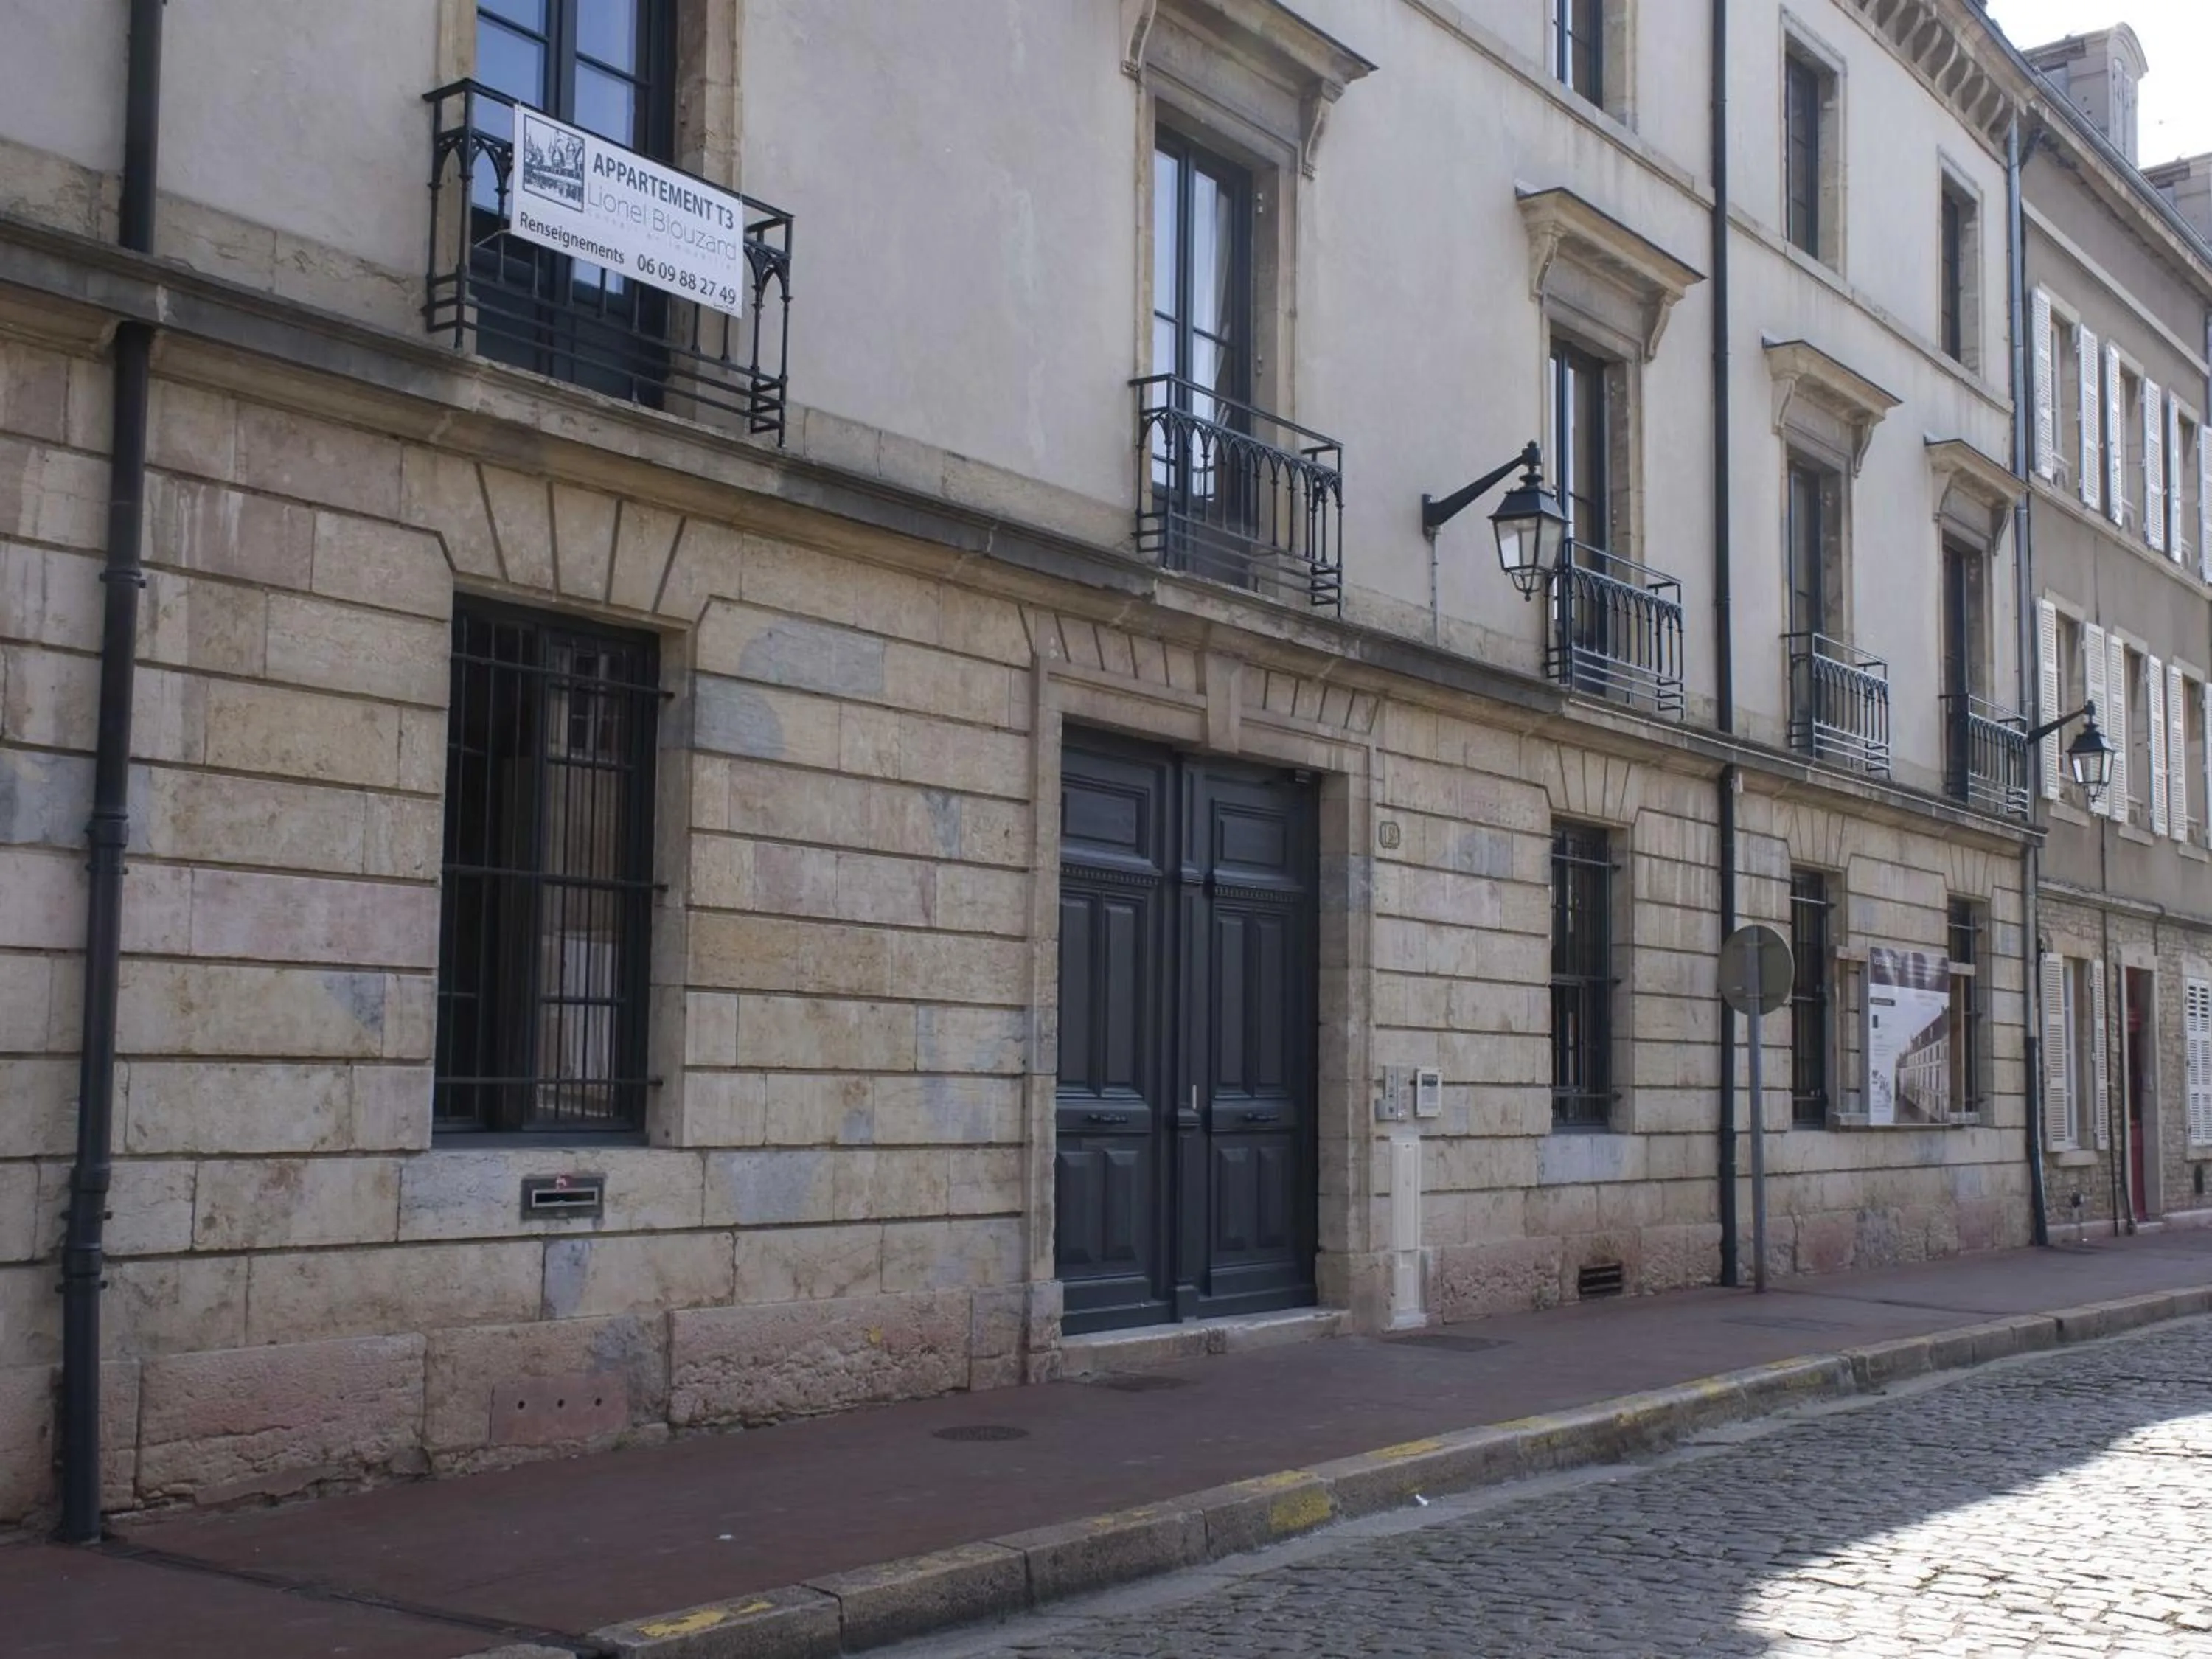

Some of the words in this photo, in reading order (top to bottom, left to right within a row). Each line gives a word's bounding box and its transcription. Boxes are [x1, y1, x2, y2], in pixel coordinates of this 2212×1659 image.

[587, 181, 647, 225] Lionel
[593, 153, 713, 220] APPARTEMENT
[716, 204, 734, 230] T3
[520, 212, 625, 264] Renseignements
[637, 254, 655, 275] 06
[658, 262, 675, 282] 09
[679, 270, 696, 290] 88
[700, 277, 717, 296] 27
[719, 285, 735, 304] 49
